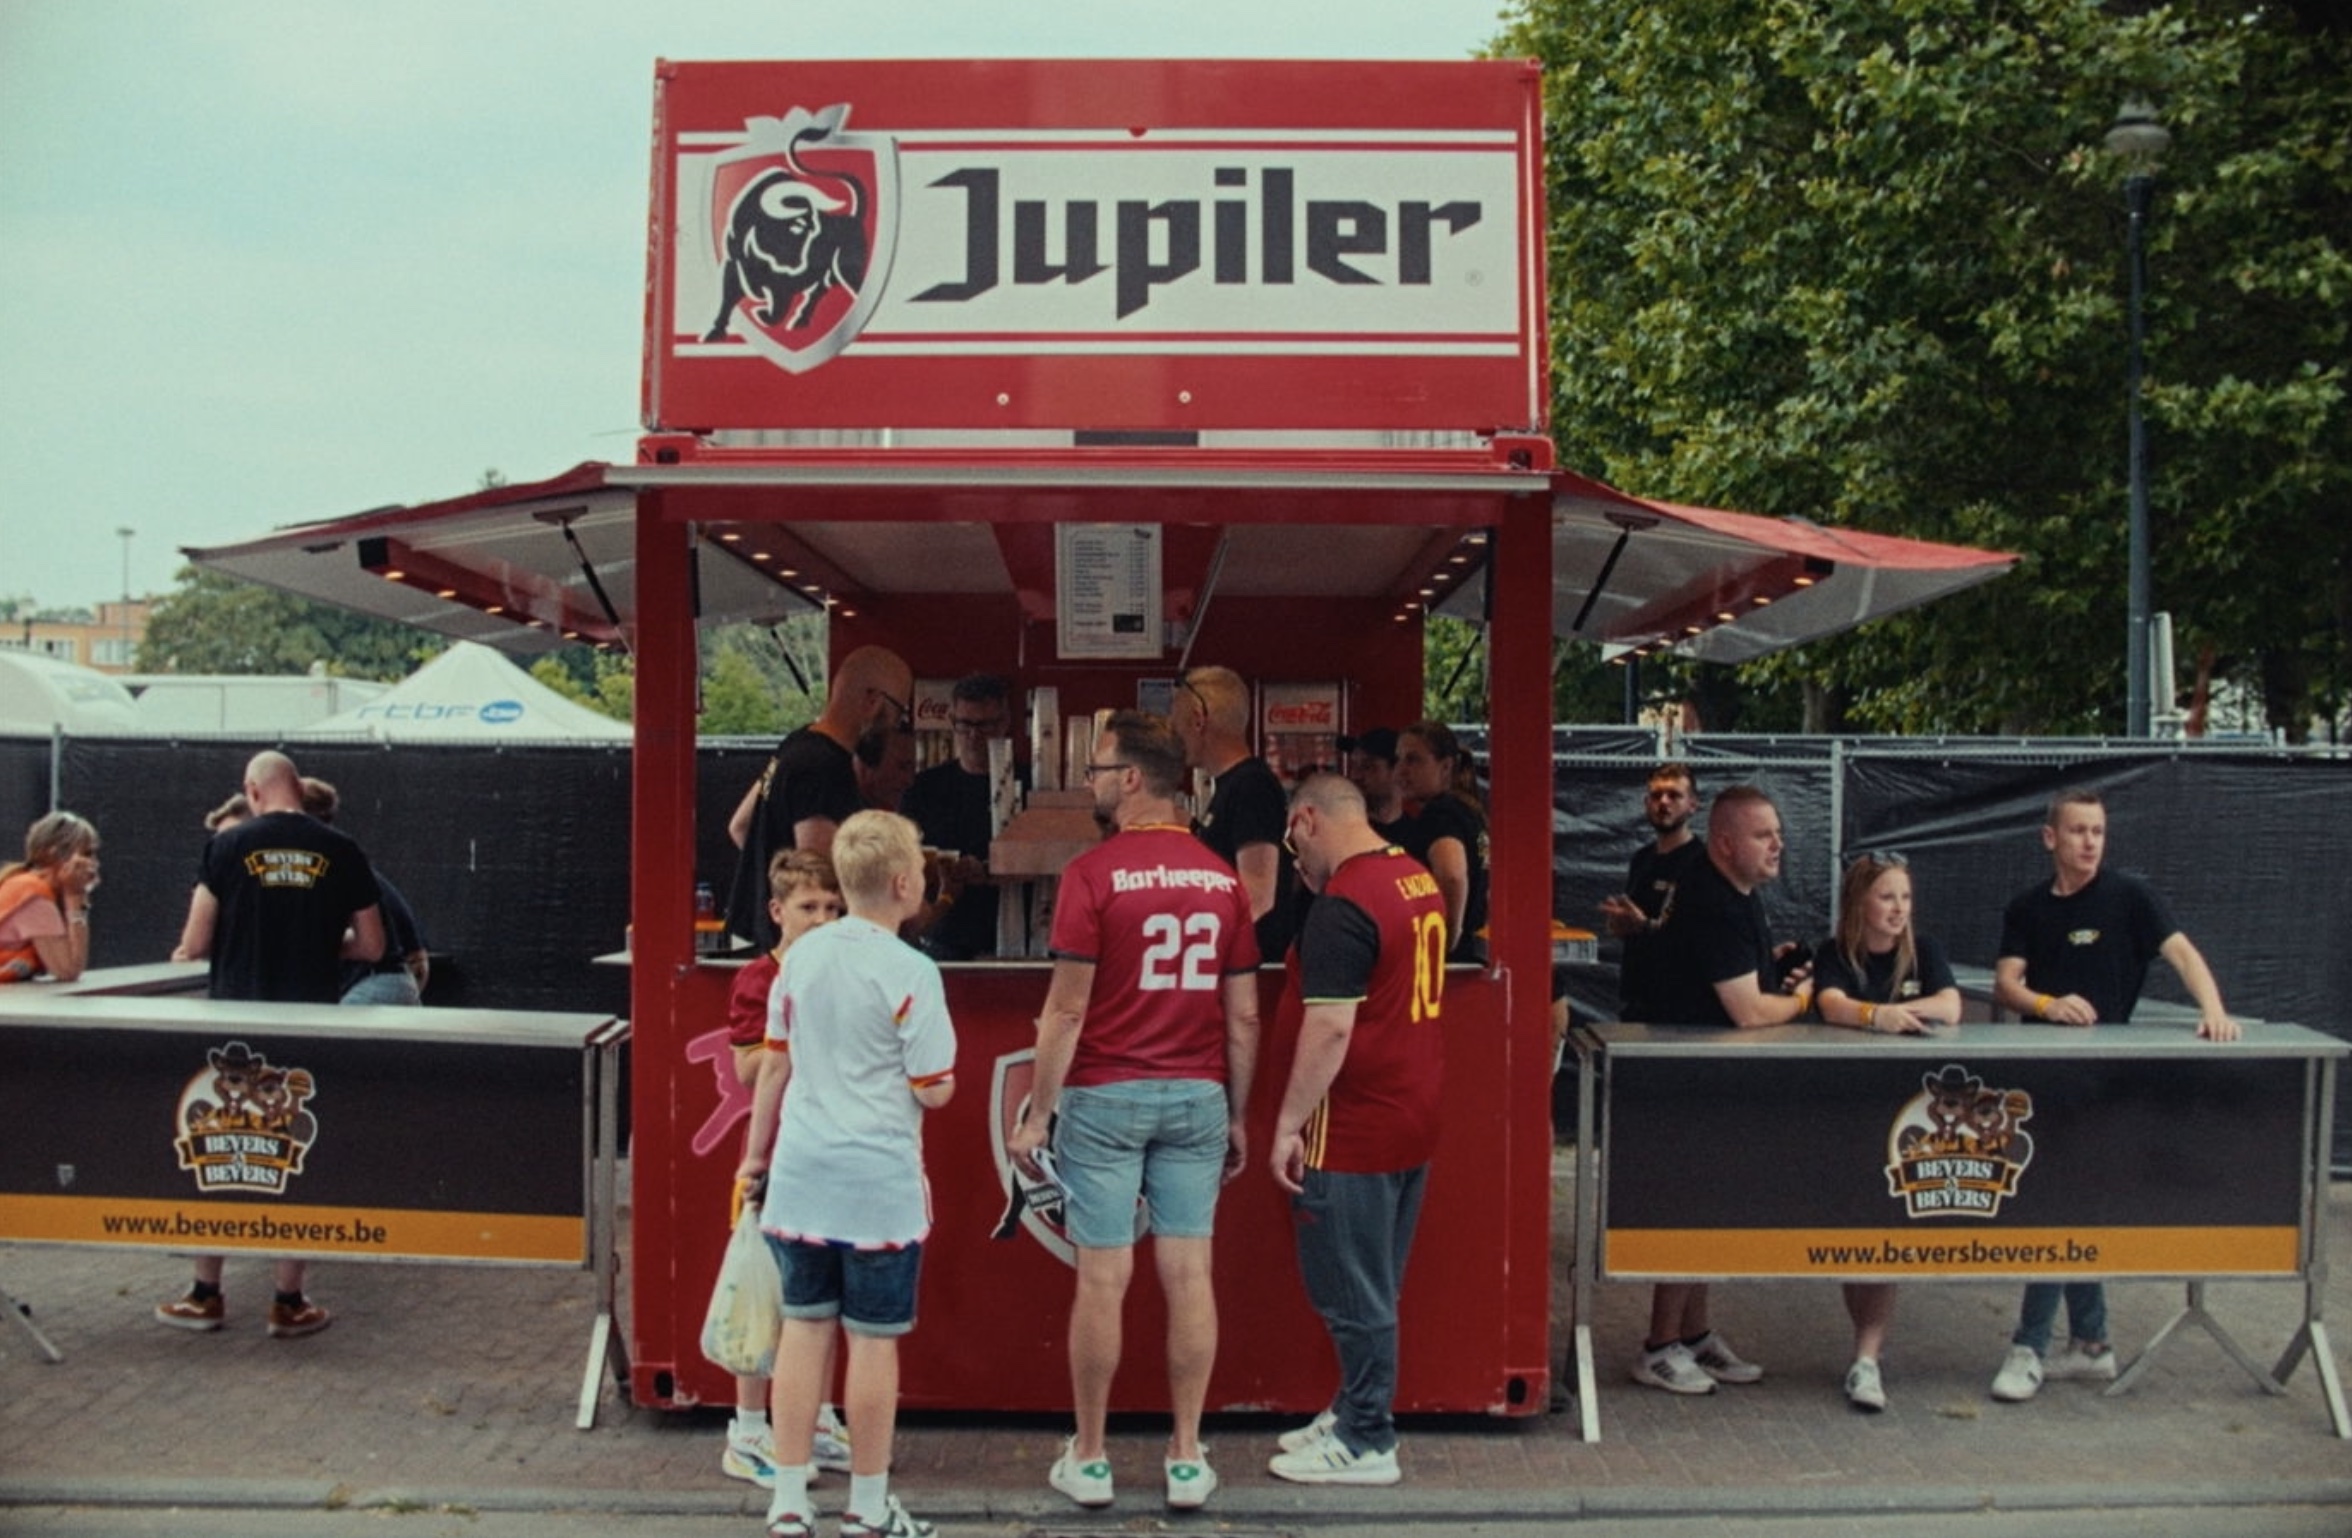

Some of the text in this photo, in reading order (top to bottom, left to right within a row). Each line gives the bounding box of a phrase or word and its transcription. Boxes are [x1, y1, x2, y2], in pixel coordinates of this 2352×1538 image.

[907, 167, 1482, 321] Jupiler
[1112, 864, 1238, 893] Barkeeper
[1138, 911, 1221, 991] 22
[1411, 911, 1448, 1024] 10
[204, 1134, 280, 1156] BEVERS
[204, 1164, 279, 1184] BEVERS
[1916, 1158, 1994, 1179] BEVERS
[1914, 1188, 1992, 1210] BEVERS
[102, 1212, 387, 1243] www.beversbevers.be
[1807, 1239, 2099, 1264] www.beversbevers.be
